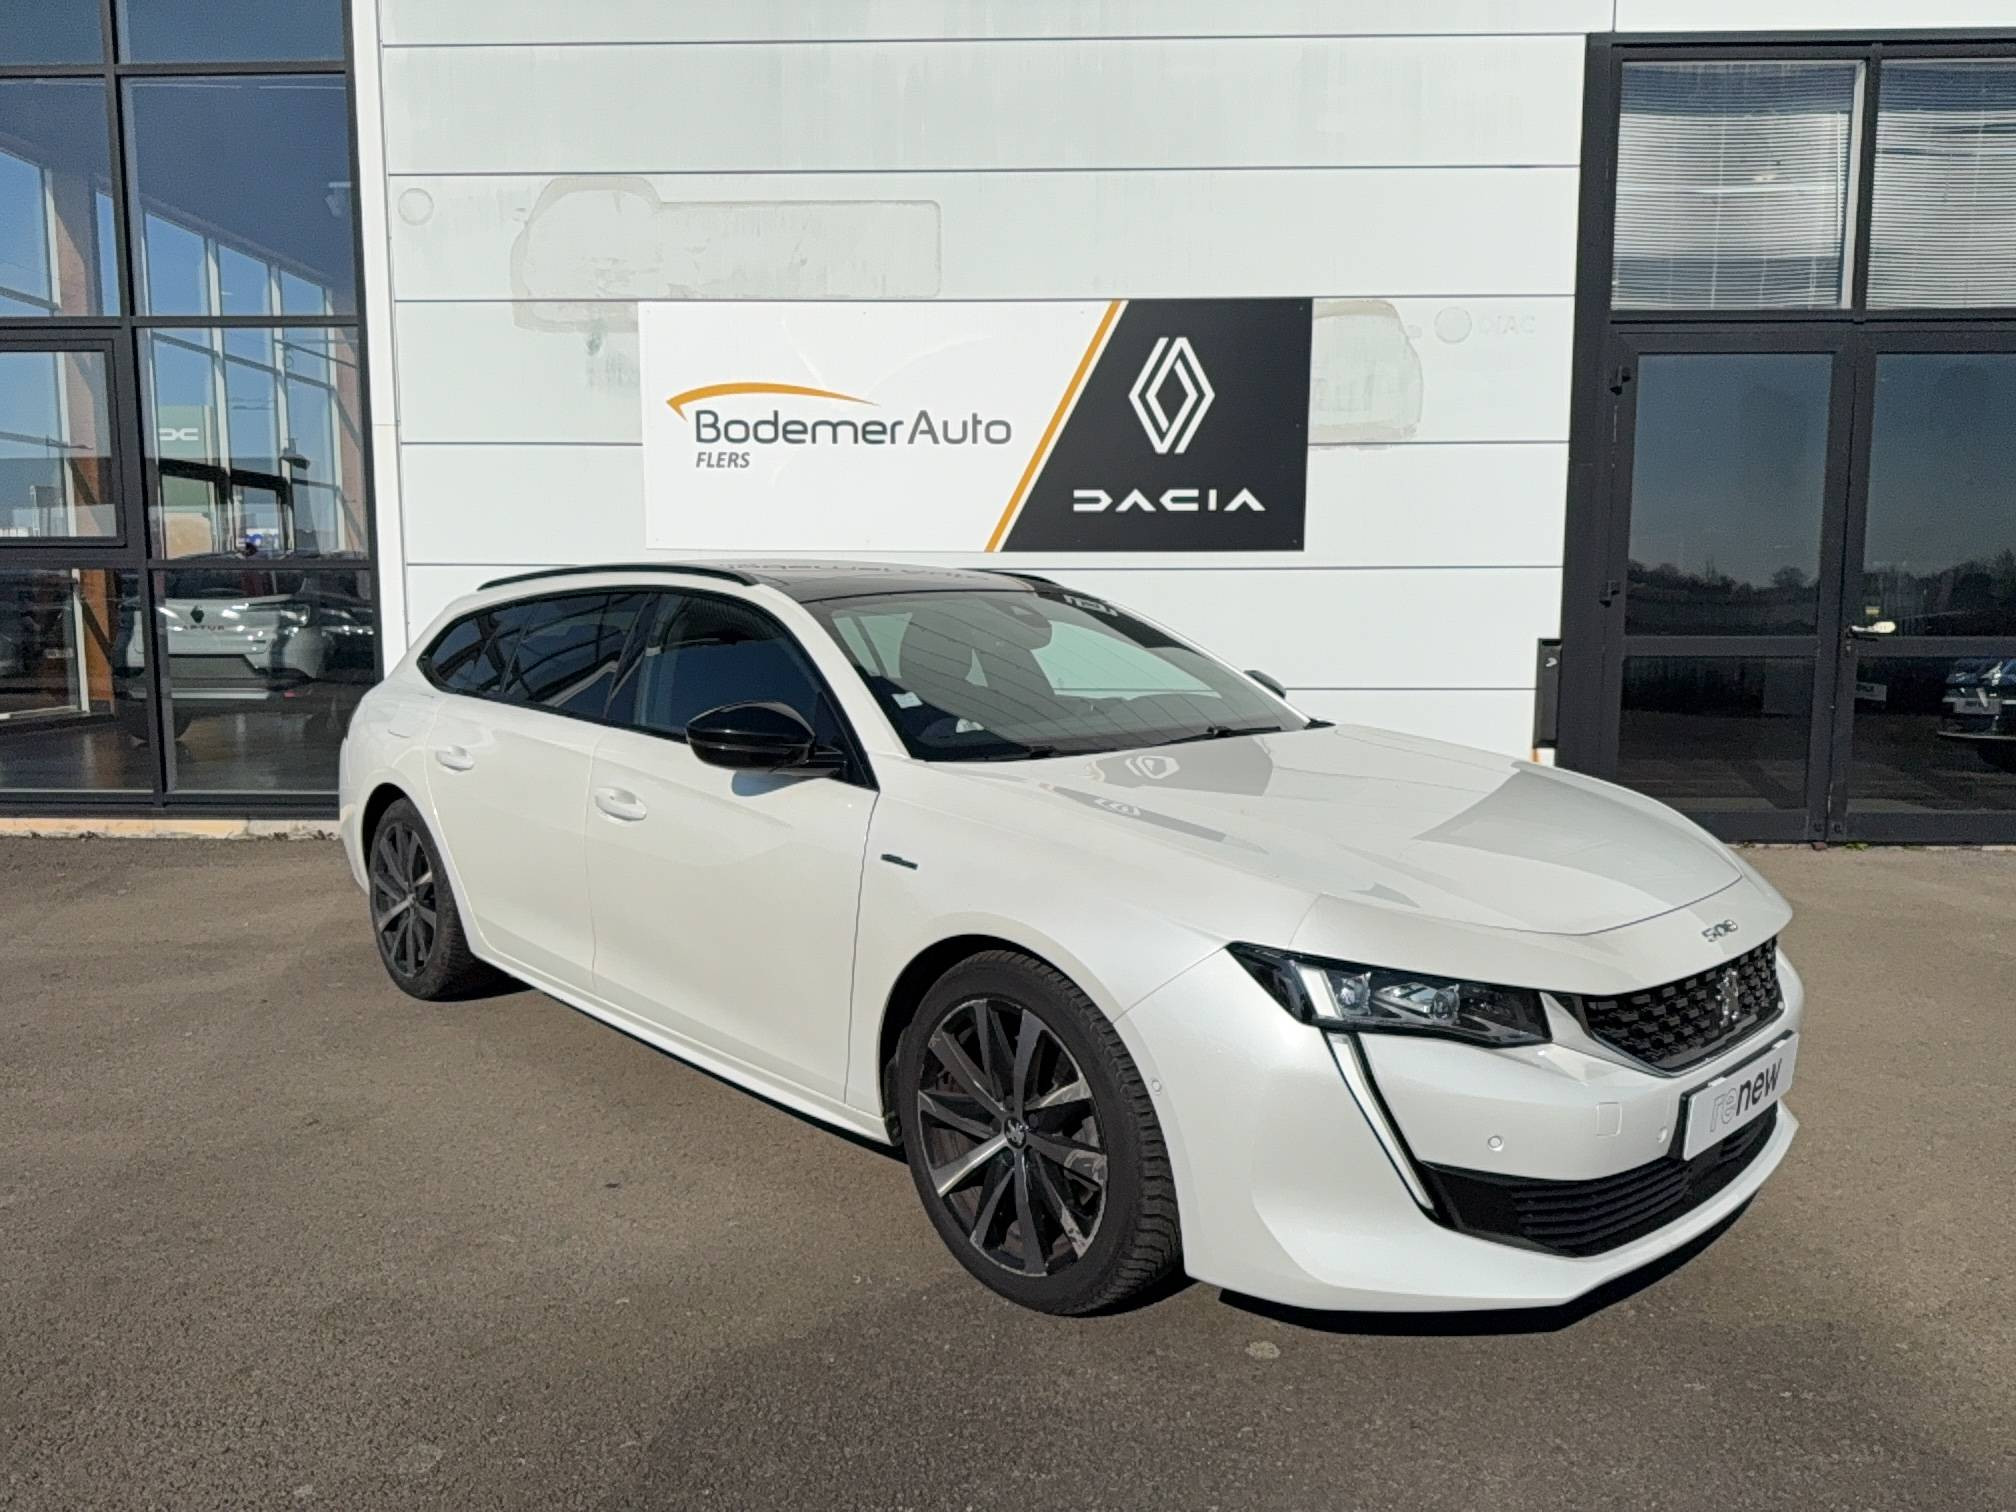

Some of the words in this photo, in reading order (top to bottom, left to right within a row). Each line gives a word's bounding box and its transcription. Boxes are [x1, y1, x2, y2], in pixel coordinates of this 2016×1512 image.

[696, 451, 750, 469] FLERS
[1073, 488, 1267, 512] DACIA
[1701, 919, 1738, 943] 508
[1710, 1058, 1782, 1133] renew
